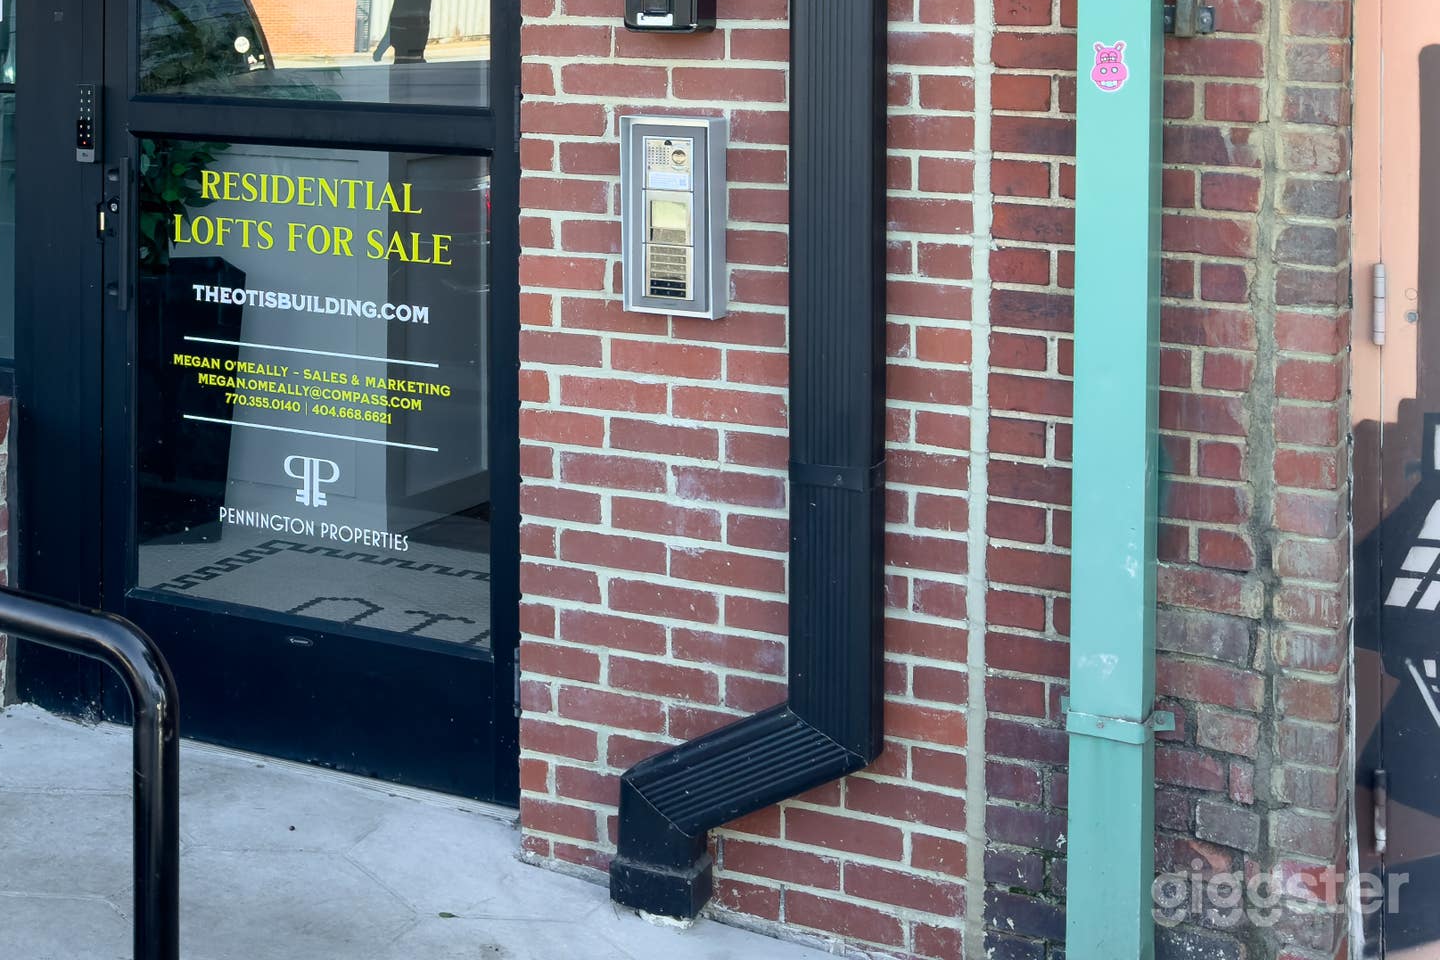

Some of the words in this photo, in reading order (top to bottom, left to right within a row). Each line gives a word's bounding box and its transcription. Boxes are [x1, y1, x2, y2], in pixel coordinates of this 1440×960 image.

[200, 169, 423, 215] RESIDENTIAL
[173, 213, 275, 251] LOFTS
[287, 221, 354, 257] FOR
[366, 229, 453, 266] SALE
[192, 284, 430, 325] THEOTISBUILDING.COM
[173, 353, 221, 371] MEGAN
[224, 359, 289, 378] O'MEALLY
[303, 368, 348, 385] SALES
[351, 374, 360, 386] &
[365, 376, 451, 397] MARKETING
[197, 372, 422, 411] MEGAN.OMEALLY@COMPASS.COM
[225, 392, 301, 413] 770.355.0140
[311, 403, 393, 425] 404.668.6621
[219, 506, 315, 537] PENNINGTON
[320, 522, 409, 553] PROPERTIES
